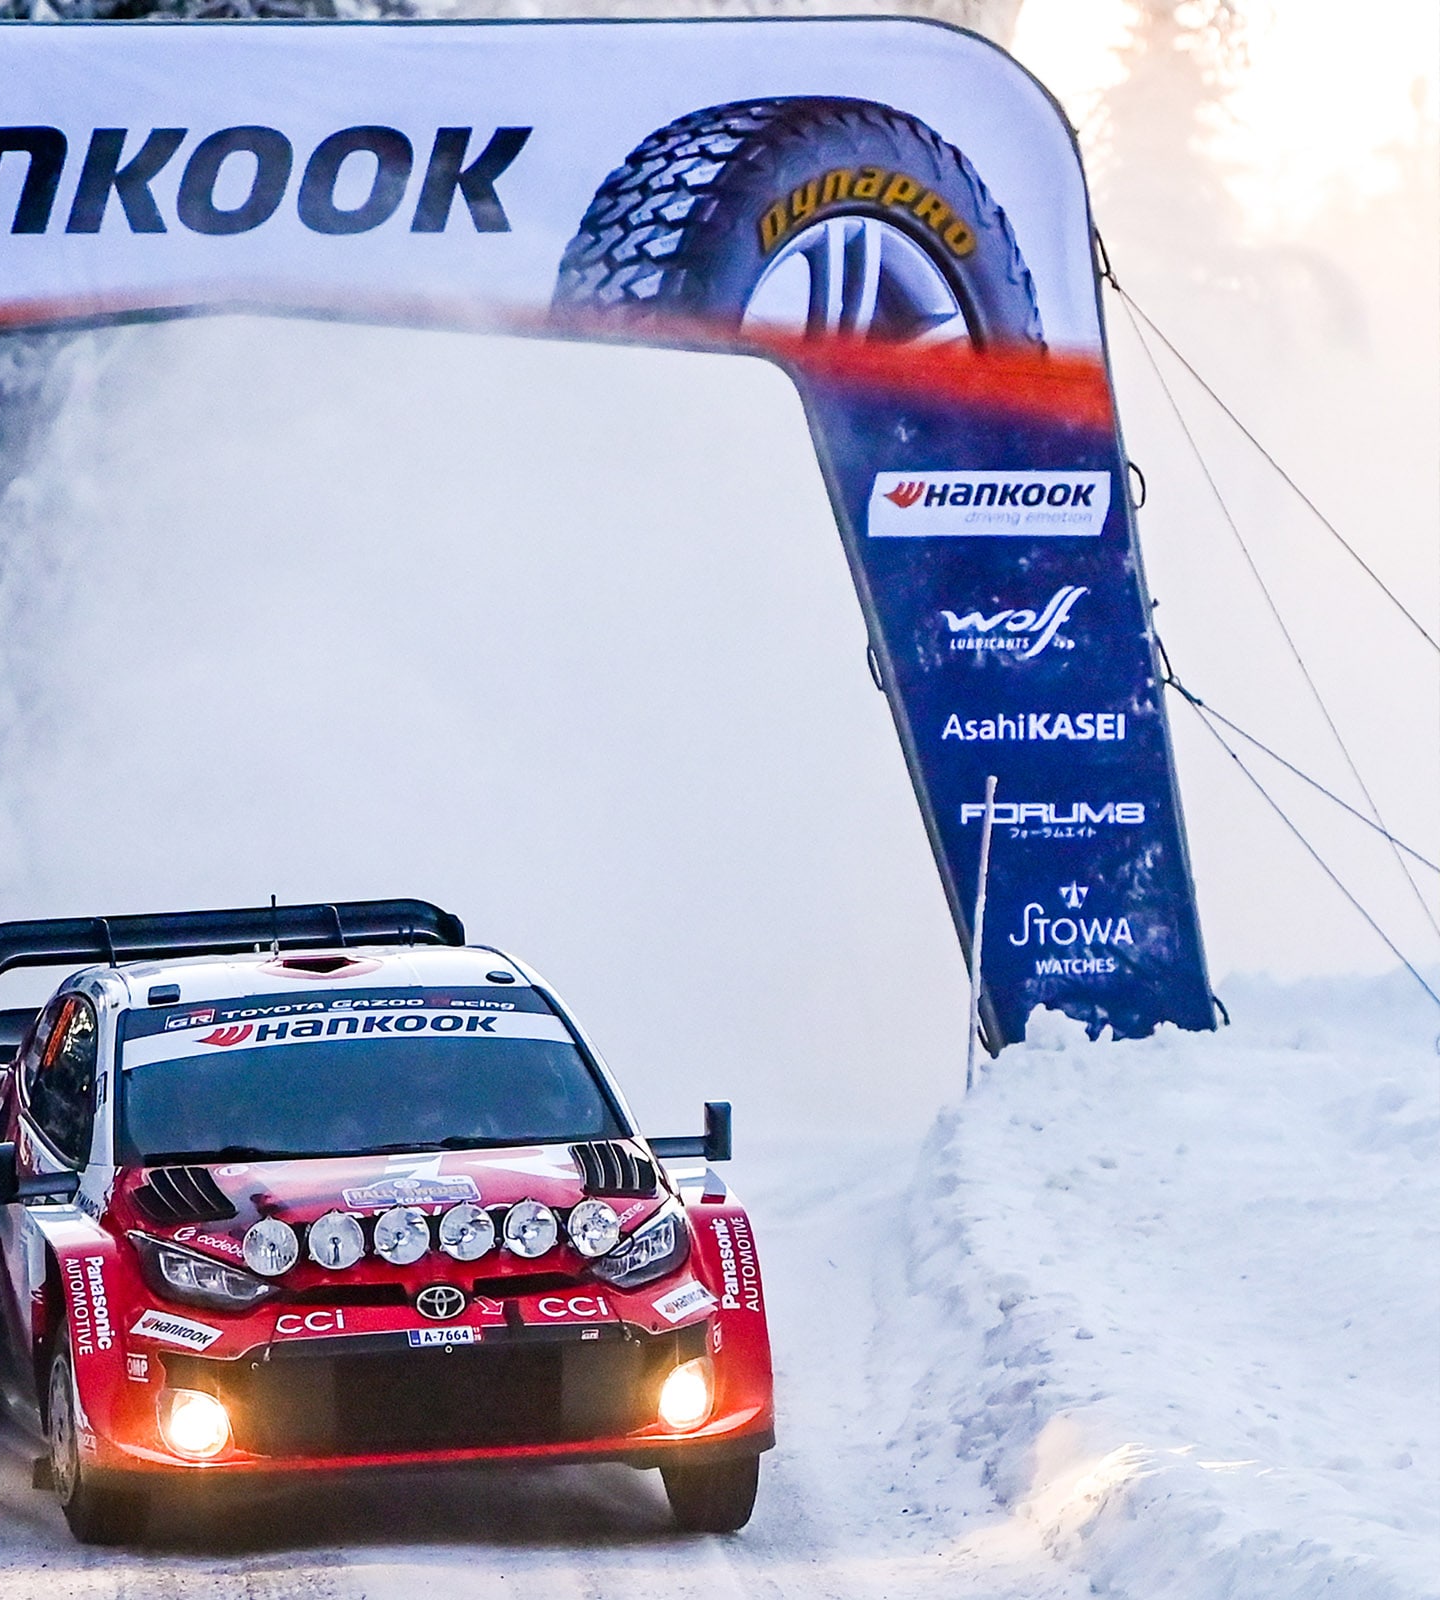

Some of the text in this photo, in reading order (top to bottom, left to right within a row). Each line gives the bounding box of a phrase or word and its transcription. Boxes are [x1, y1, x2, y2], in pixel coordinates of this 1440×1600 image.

[964, 511, 1093, 526] driving emotion
[949, 637, 1030, 651] LUBRICANTS
[960, 802, 1145, 825] FORUM8
[1009, 903, 1135, 946] STOWA
[1035, 957, 1117, 976] WATCHES
[166, 1011, 215, 1030] GR
[221, 1002, 324, 1020] TOYOTA
[331, 998, 425, 1009] GAZOO
[352, 1188, 399, 1201] RALLY
[709, 1218, 740, 1311] Panasonic
[730, 1216, 760, 1312] AUTOMOTIVE
[65, 1258, 93, 1356] AUTOMOTIVE
[85, 1256, 115, 1350] Panasonic
[424, 1329, 469, 1343] A-7664
